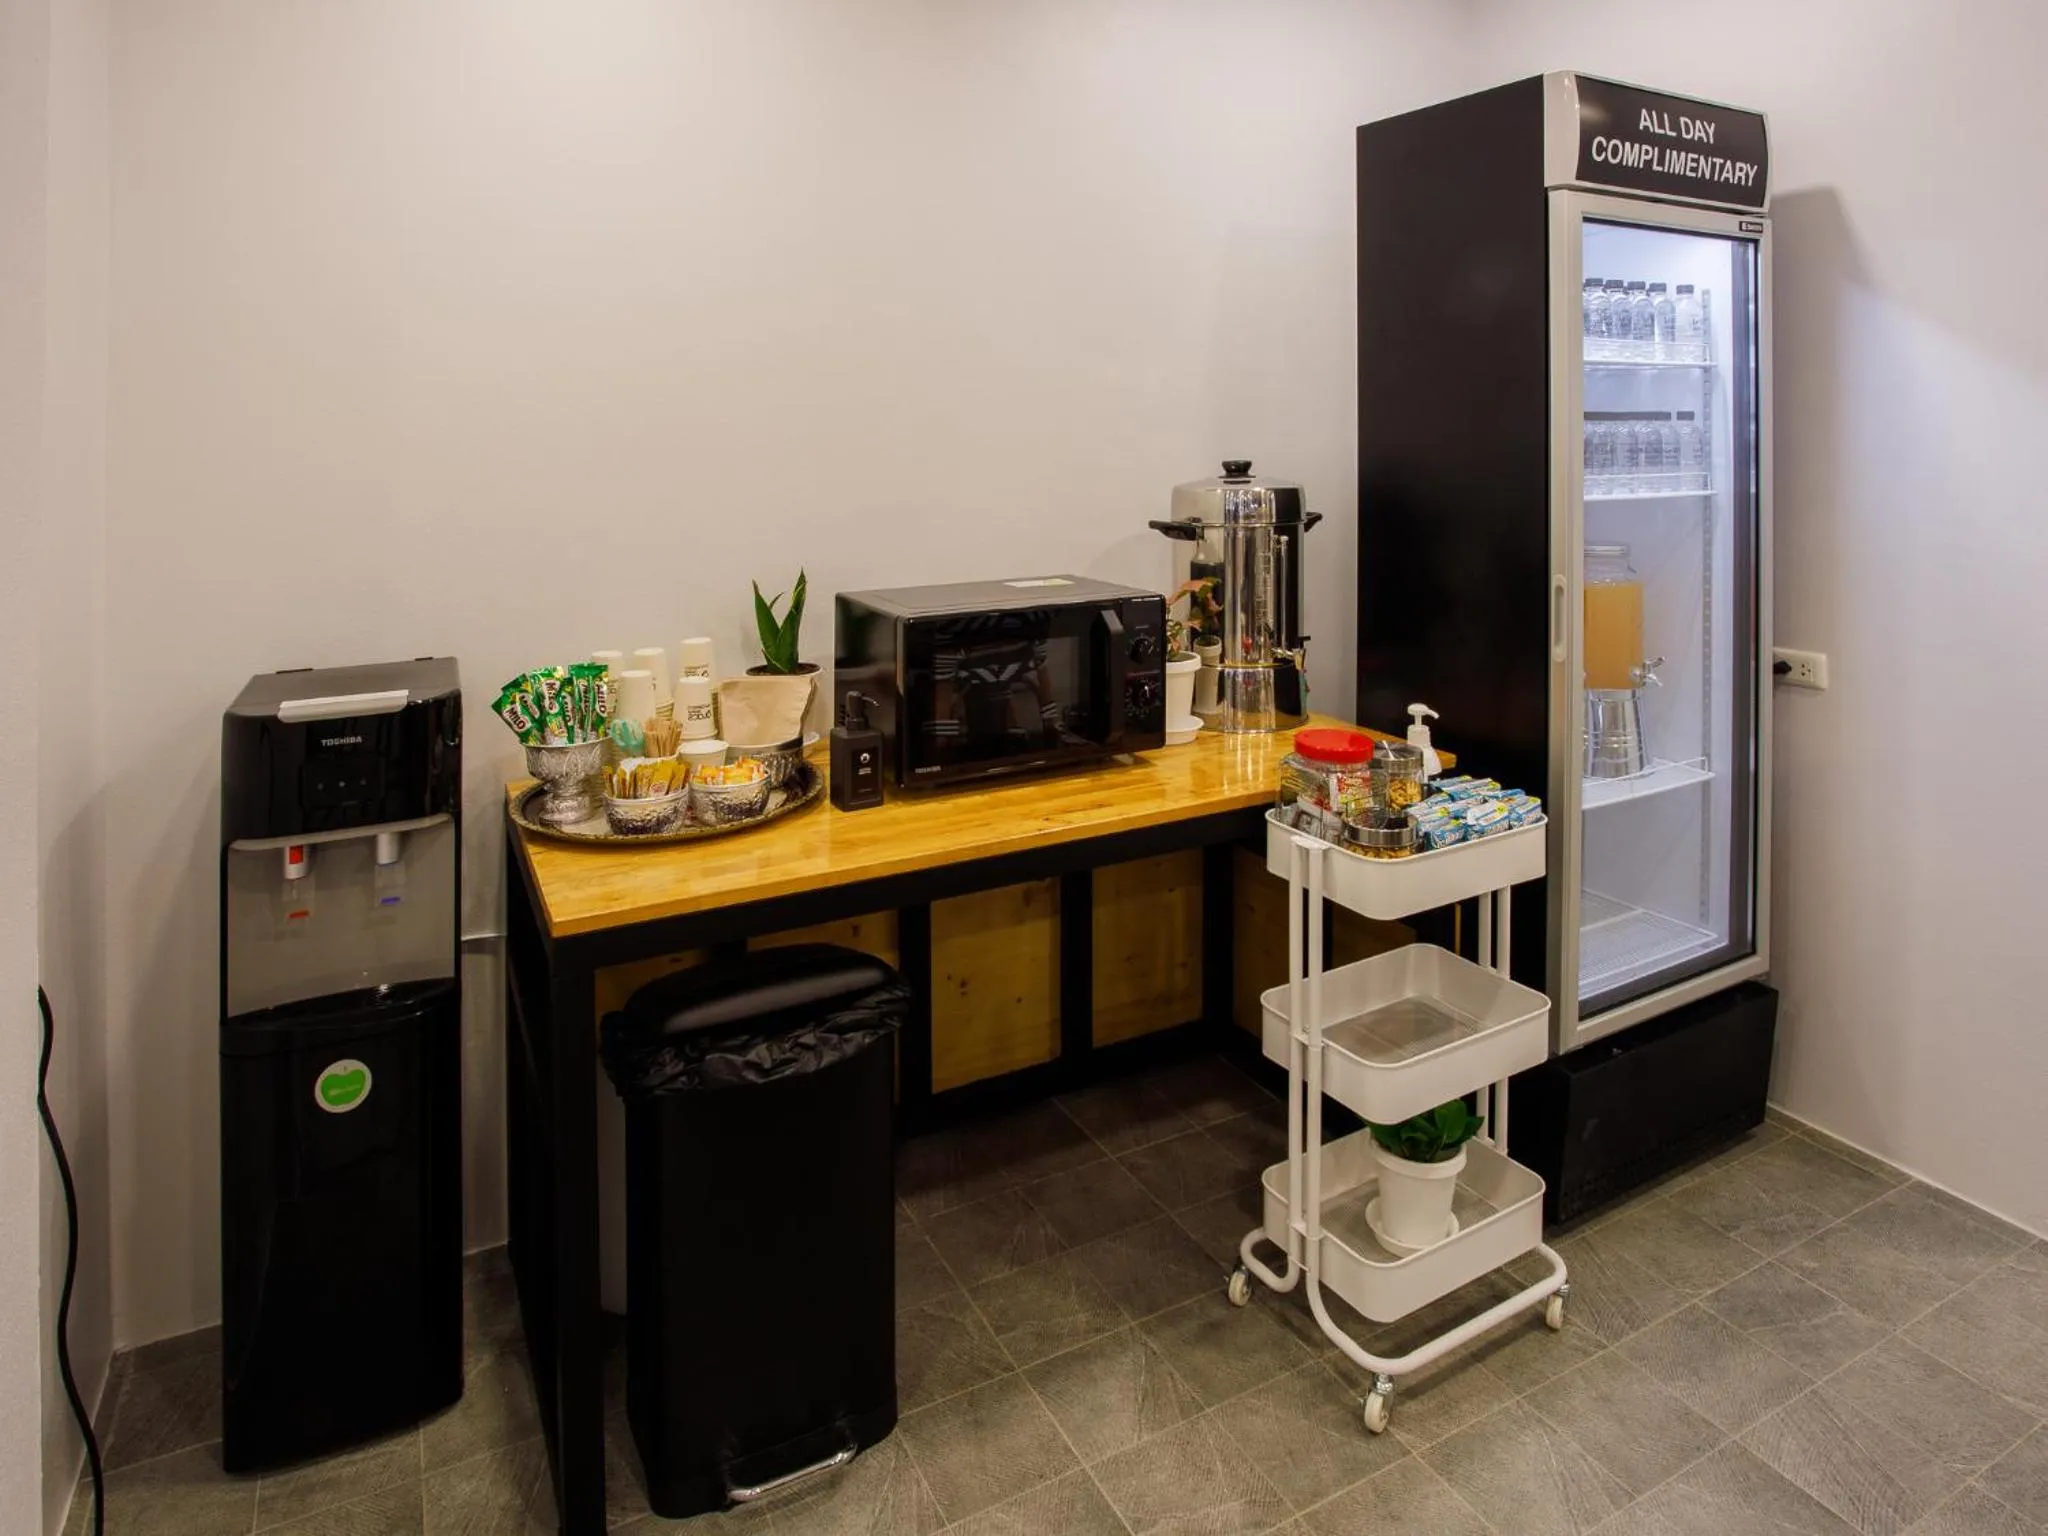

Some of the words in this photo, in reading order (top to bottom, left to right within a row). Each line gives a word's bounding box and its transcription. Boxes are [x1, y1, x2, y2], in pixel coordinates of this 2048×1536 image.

[1639, 108, 1677, 137] ALL
[1680, 115, 1716, 145] DAY
[1591, 135, 1758, 187] COMPLIMENTARY
[506, 705, 528, 730] MILO
[321, 736, 362, 747] TOSHIBA
